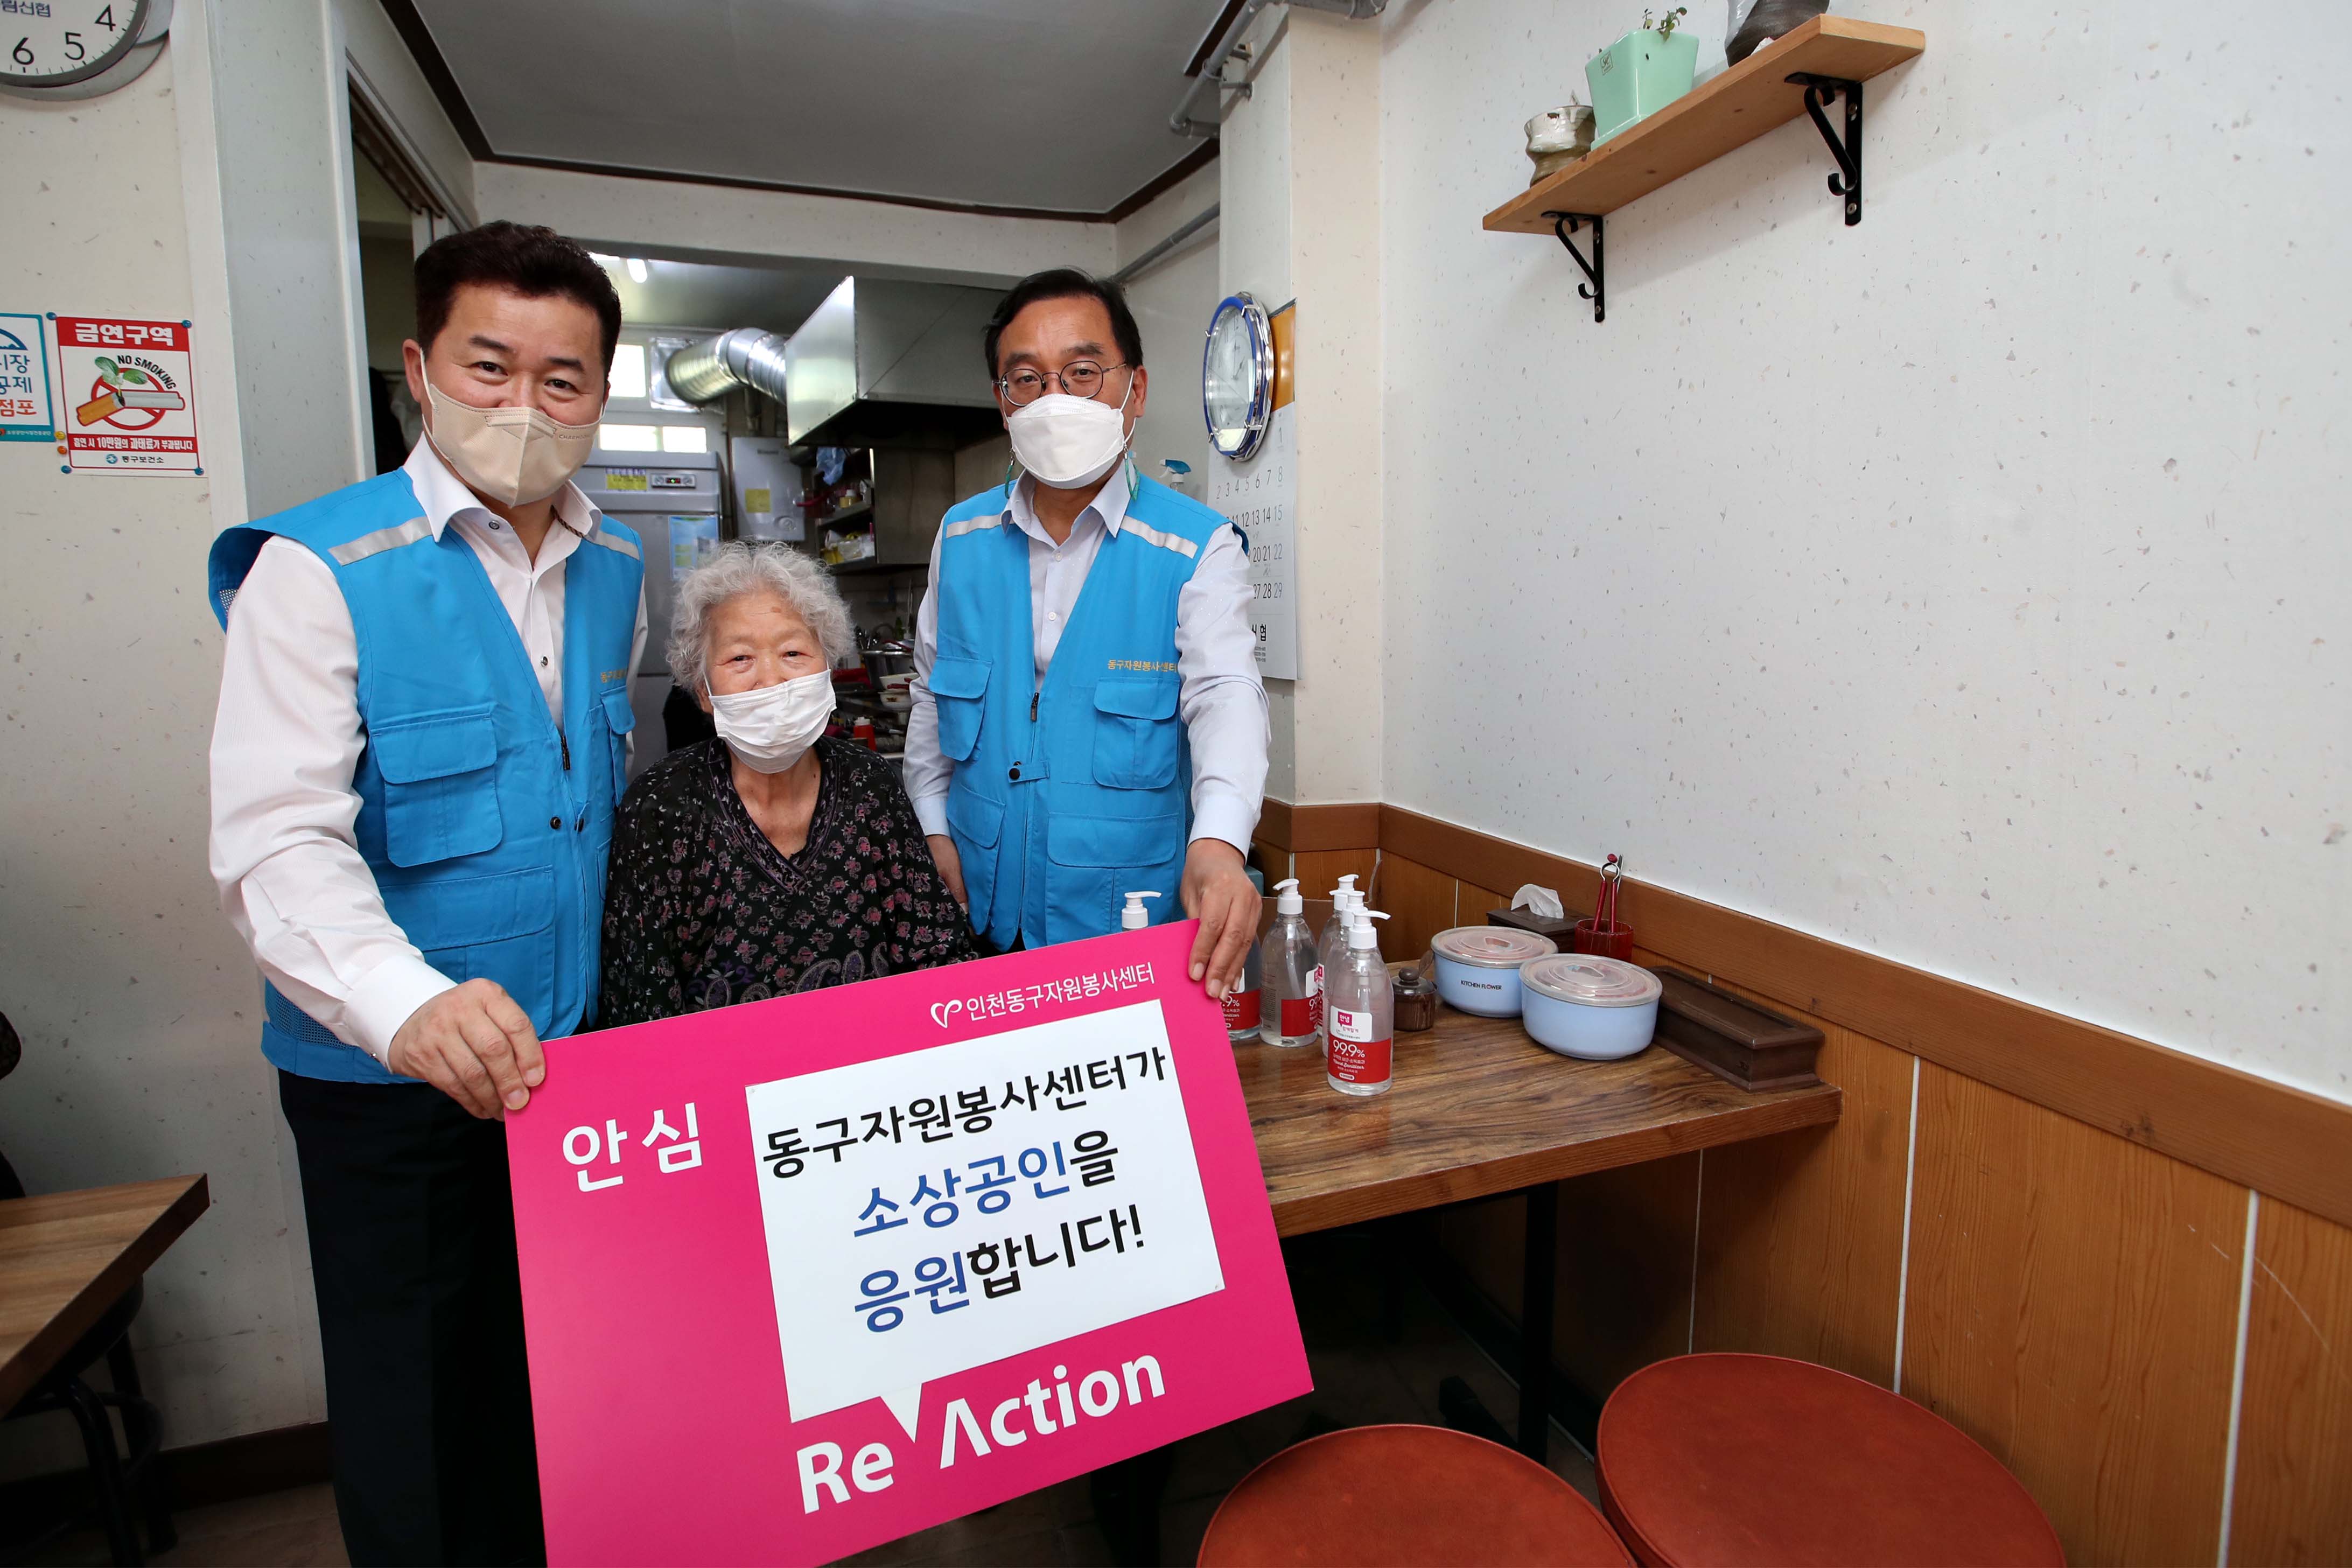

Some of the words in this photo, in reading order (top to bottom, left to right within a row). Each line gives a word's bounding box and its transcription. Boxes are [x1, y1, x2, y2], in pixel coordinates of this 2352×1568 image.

[95, 5, 116, 31] 4
[12, 37, 34, 65] 6
[65, 32, 85, 60] 5
[75, 323, 174, 347] 금연구역
[117, 355, 132, 364] NO
[134, 357, 176, 389] SMOKING
[73, 437, 87, 448] 흡연
[88, 439, 95, 448] 시
[97, 437, 129, 449] 10만원의
[130, 438, 160, 450] 과태료가
[162, 440, 193, 450] 부과됩니다
[1279, 427, 1283, 443] 1
[1216, 485, 1221, 499] 2
[1226, 482, 1230, 497] 3
[1235, 479, 1240, 493] 4
[1245, 476, 1250, 492] 5
[1255, 473, 1260, 488] 6
[1266, 470, 1271, 485] 7
[1278, 466, 1283, 482] 8
[1242, 511, 1249, 527] 12
[1252, 509, 1259, 526] 13
[1263, 507, 1271, 523] 14
[1274, 504, 1283, 521] 15
[1253, 547, 1261, 562] 20
[1263, 545, 1271, 561] 21
[1274, 543, 1282, 559] 22
[1254, 584, 1261, 599] 27
[1263, 583, 1271, 599] 28
[1274, 583, 1282, 598] 29
[1108, 659, 1177, 673] 동구자원봉사센터
[967, 962, 1154, 1021] 인천동구자원봉사센터
[1461, 980, 1481, 988] KITCHEN
[1340, 1014, 1350, 1023] 안녕
[1333, 1039, 1366, 1058] 99.9%
[763, 1047, 1166, 1179] 동구자원봉사센터가
[853, 1130, 1118, 1237] 소상공인을
[855, 1205, 1145, 1333] 응원합니다!
[796, 1442, 894, 1514] Re
